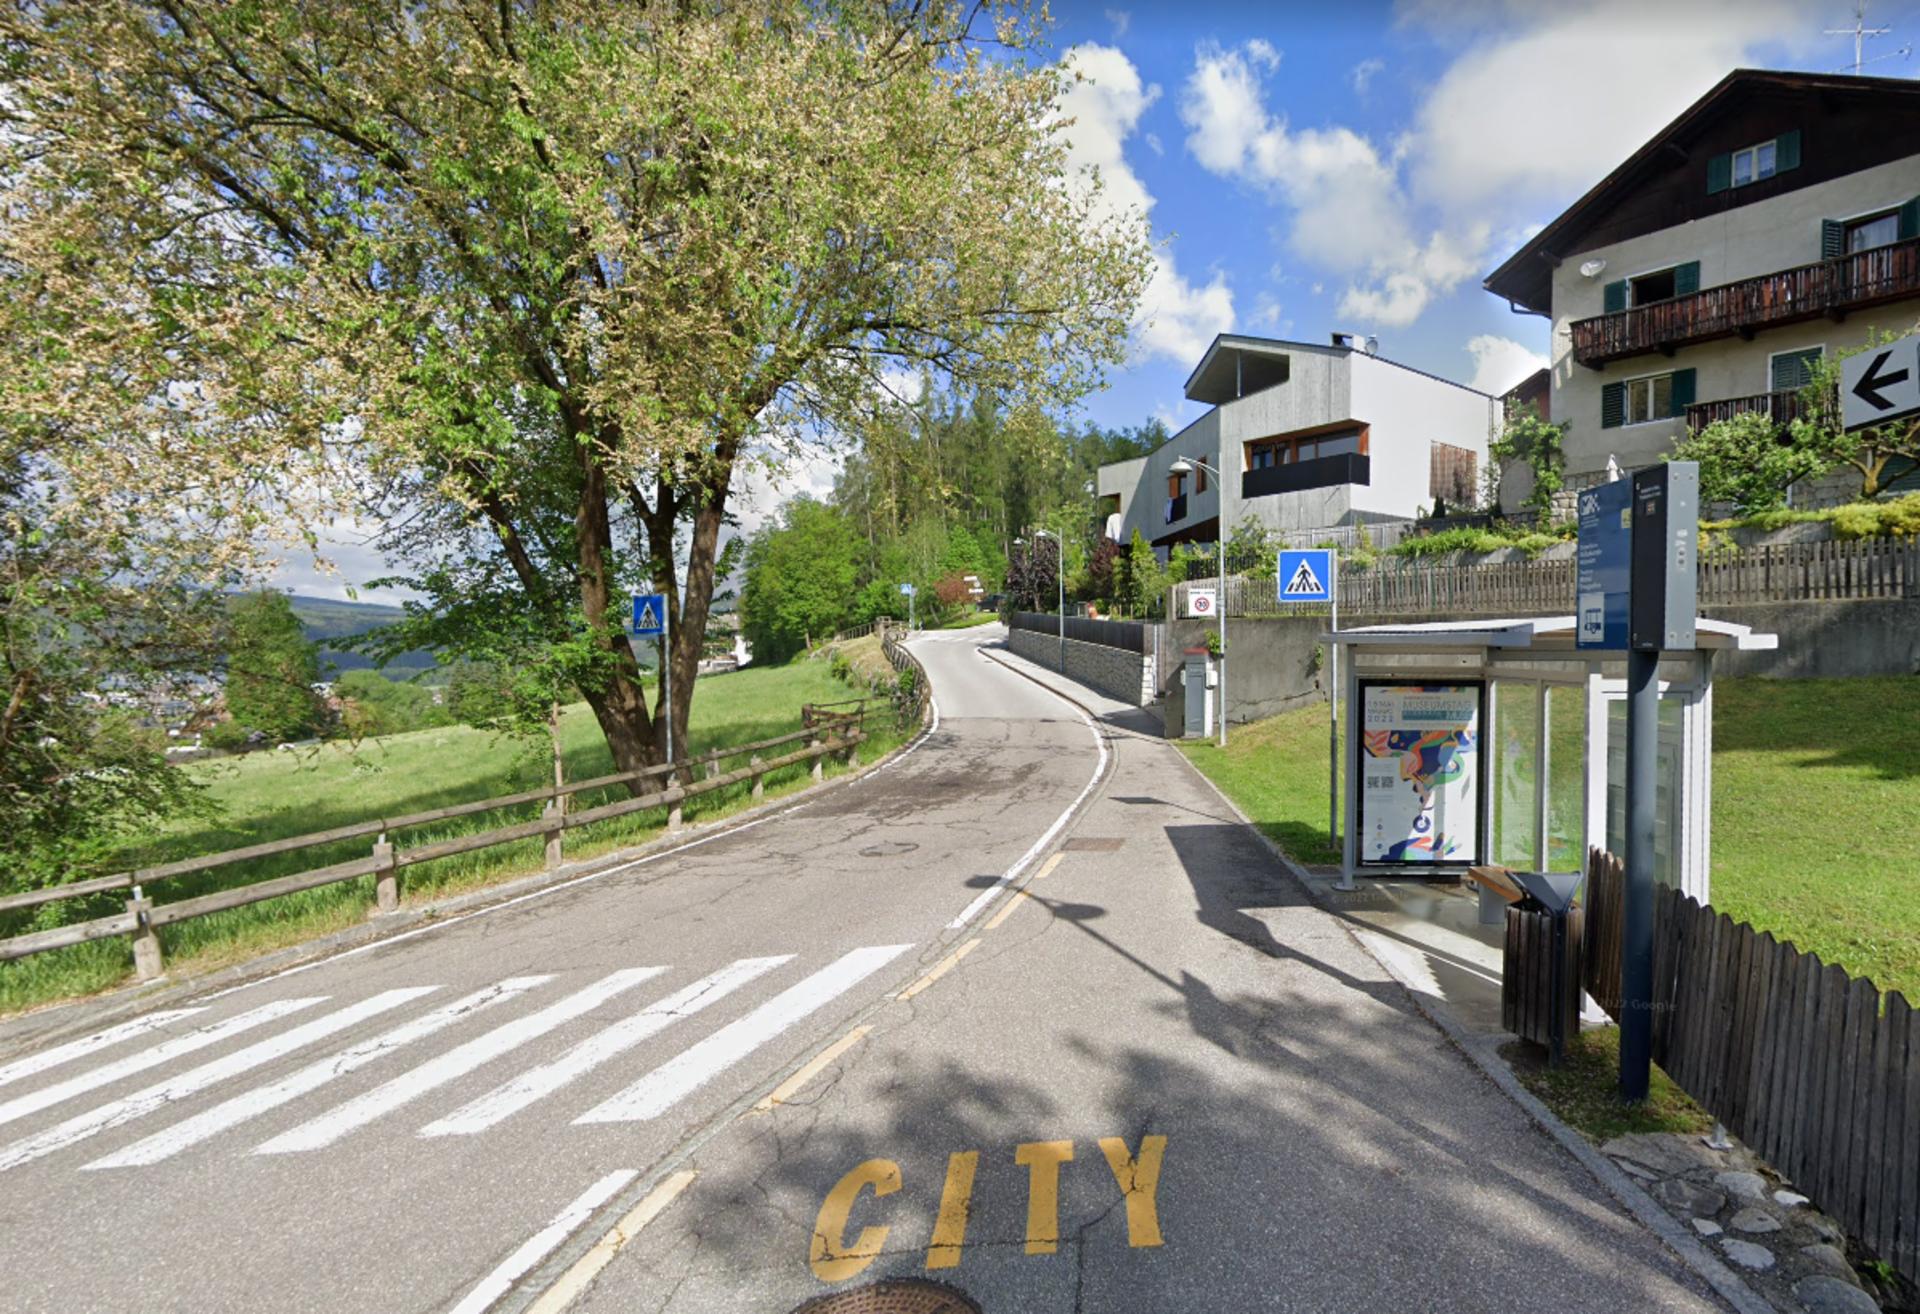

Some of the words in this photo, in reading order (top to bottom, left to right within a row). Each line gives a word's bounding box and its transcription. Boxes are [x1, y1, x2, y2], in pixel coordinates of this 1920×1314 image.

[1403, 701, 1472, 711] MUSEUMSTAG
[1367, 715, 1394, 723] 2022
[810, 1135, 1167, 1282] CITY
